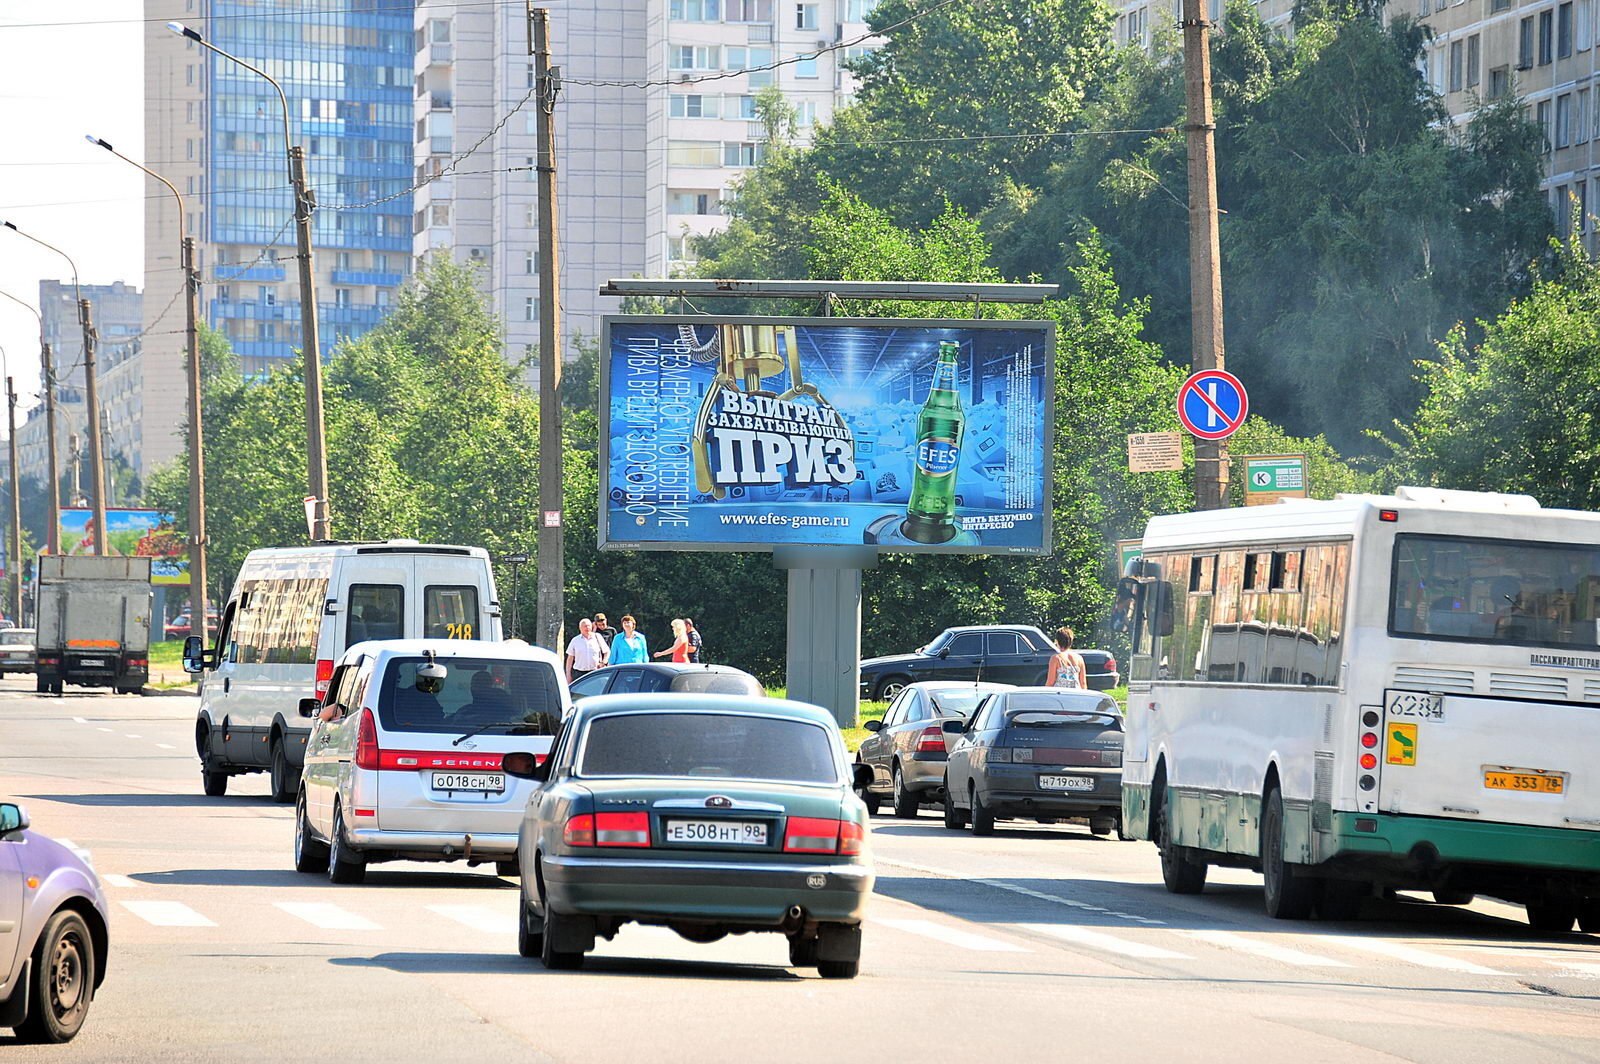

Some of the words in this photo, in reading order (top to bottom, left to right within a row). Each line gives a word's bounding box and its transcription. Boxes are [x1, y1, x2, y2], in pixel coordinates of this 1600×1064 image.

[627, 337, 659, 377] ПИВА
[660, 338, 691, 424] ЧРЕЗМЕРНОЕ
[624, 380, 659, 431] ВРЕДИТ
[721, 389, 838, 427] ВЫИГРАЙ
[714, 428, 857, 484] ПРИЗ
[920, 446, 957, 464] EFES
[624, 433, 658, 516] ЗДОРОВЬЮ
[658, 426, 690, 527] УПОТРЕБЛЕНИЕ
[720, 513, 849, 528] www.efes-game.ru
[988, 512, 1033, 522] БЕЗУМНО
[962, 521, 1015, 531] ИНТЕРЕСНО
[447, 623, 472, 640] 218
[488, 776, 501, 785] 98
[1081, 778, 1091, 786] 98
[1492, 777, 1506, 788] АК
[1513, 776, 1537, 789] 353
[1545, 777, 1558, 788] 78
[744, 825, 760, 838] 98
[809, 876, 825, 886] RUS
